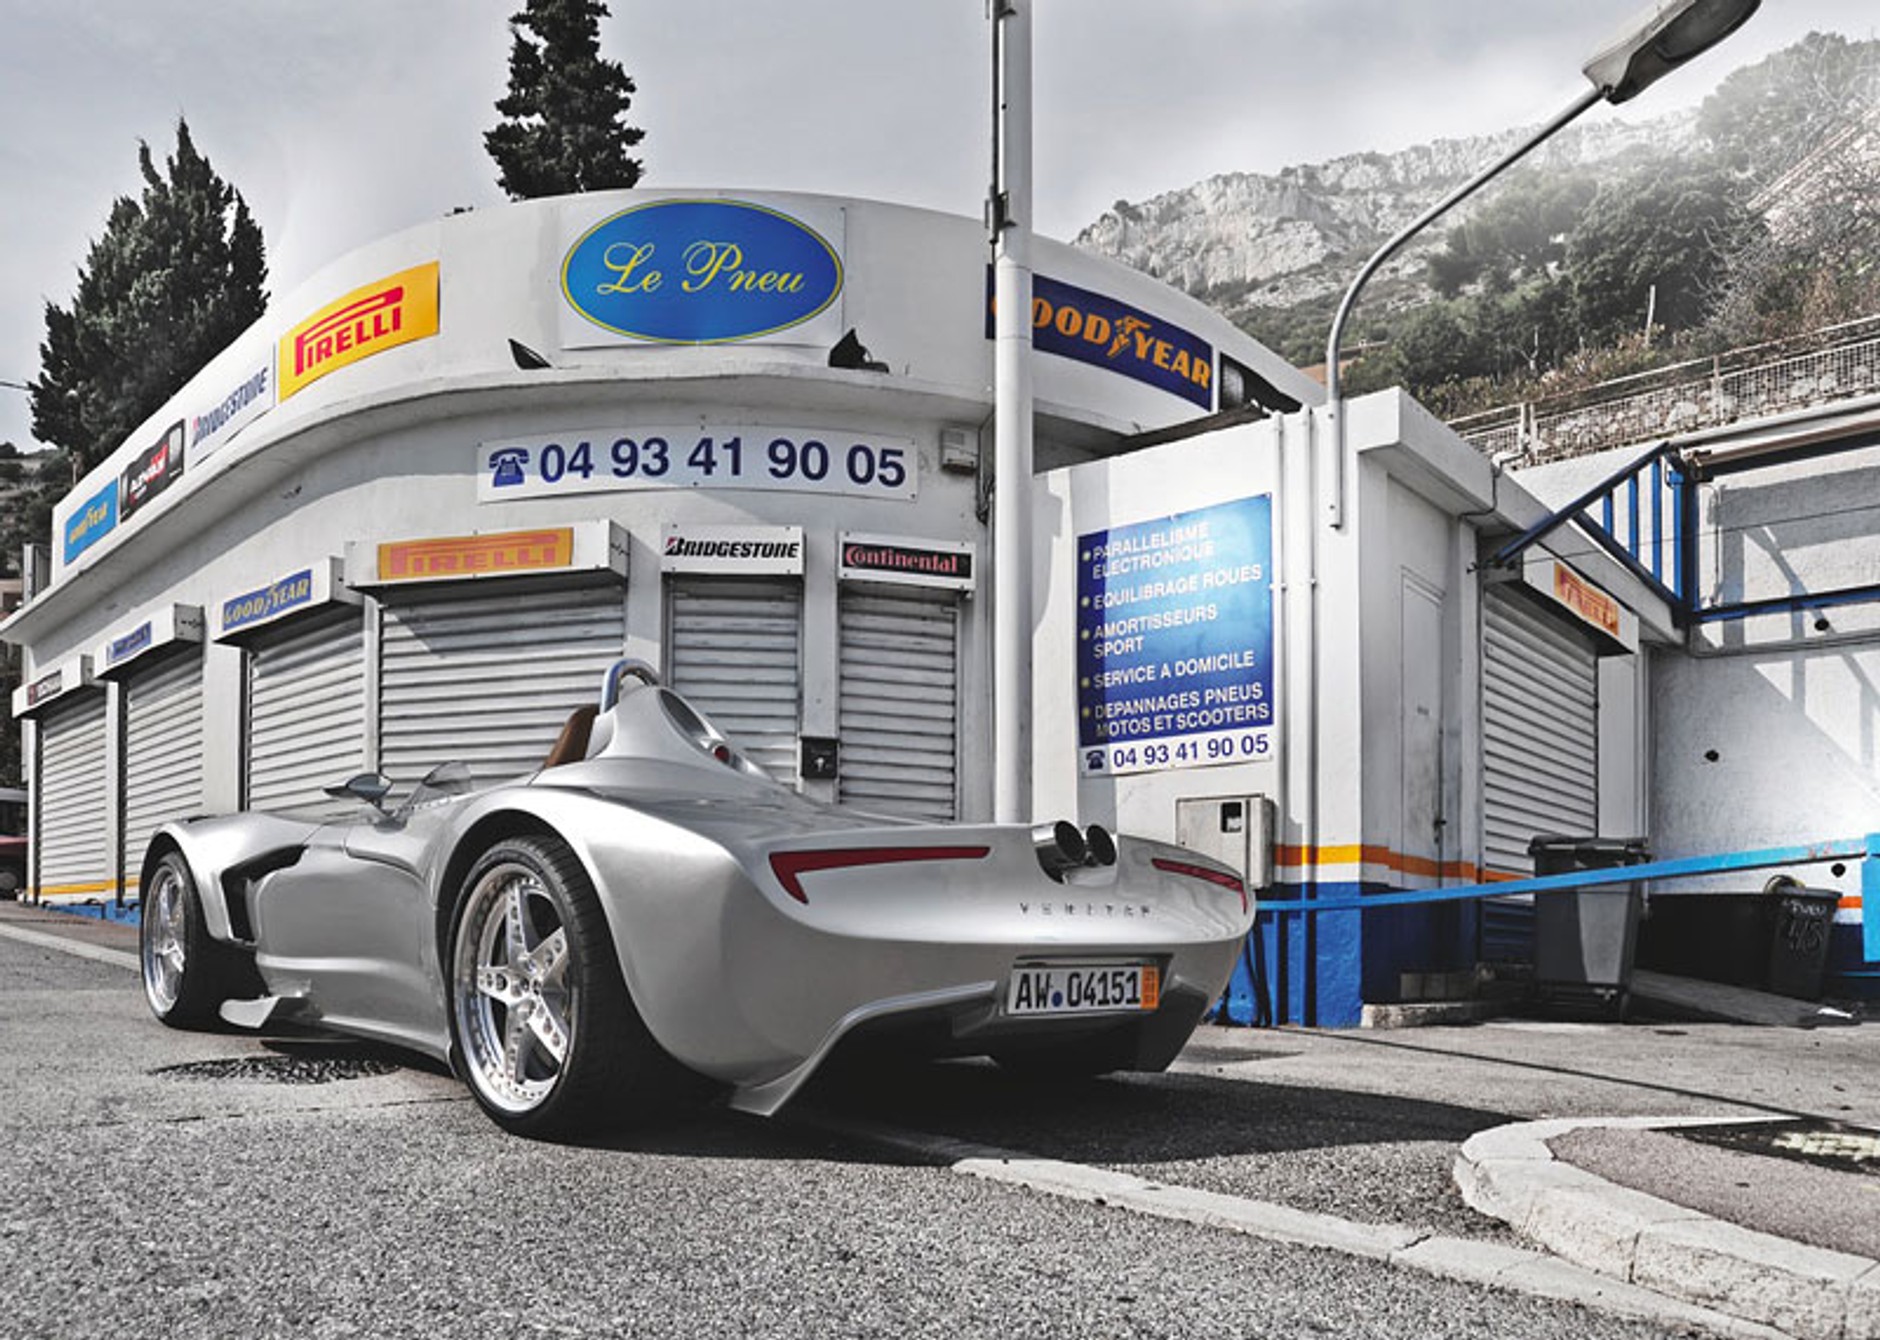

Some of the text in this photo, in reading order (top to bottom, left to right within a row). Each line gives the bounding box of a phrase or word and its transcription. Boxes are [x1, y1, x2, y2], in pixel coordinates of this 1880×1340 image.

[597, 240, 805, 295] Le Pneu
[295, 285, 404, 377] PIRELLI
[993, 296, 1212, 389] OODYEAR
[540, 436, 906, 488] 04 93 41 90 05
[390, 532, 559, 576] PIRELLI
[664, 536, 800, 560] BRIDGESTONE
[846, 546, 958, 574] Continental
[1093, 522, 1210, 562] PARALLELISME
[1093, 540, 1215, 580] ELECTRONIQUE
[1094, 564, 1262, 610] EQUILIBRAGE ROUES
[1093, 603, 1218, 640] AMORTISSEURS
[1093, 637, 1144, 659] SPORT
[1093, 650, 1255, 689] SERVICE A DOMICILE
[1095, 682, 1263, 719] DEPANNAGES PNEUS
[1096, 703, 1270, 737] MOTOS ET SCOOTERS
[1113, 733, 1269, 768] 04 93 41 90 05
[1015, 972, 1051, 1010] AW
[1066, 970, 1141, 1008] 04151
